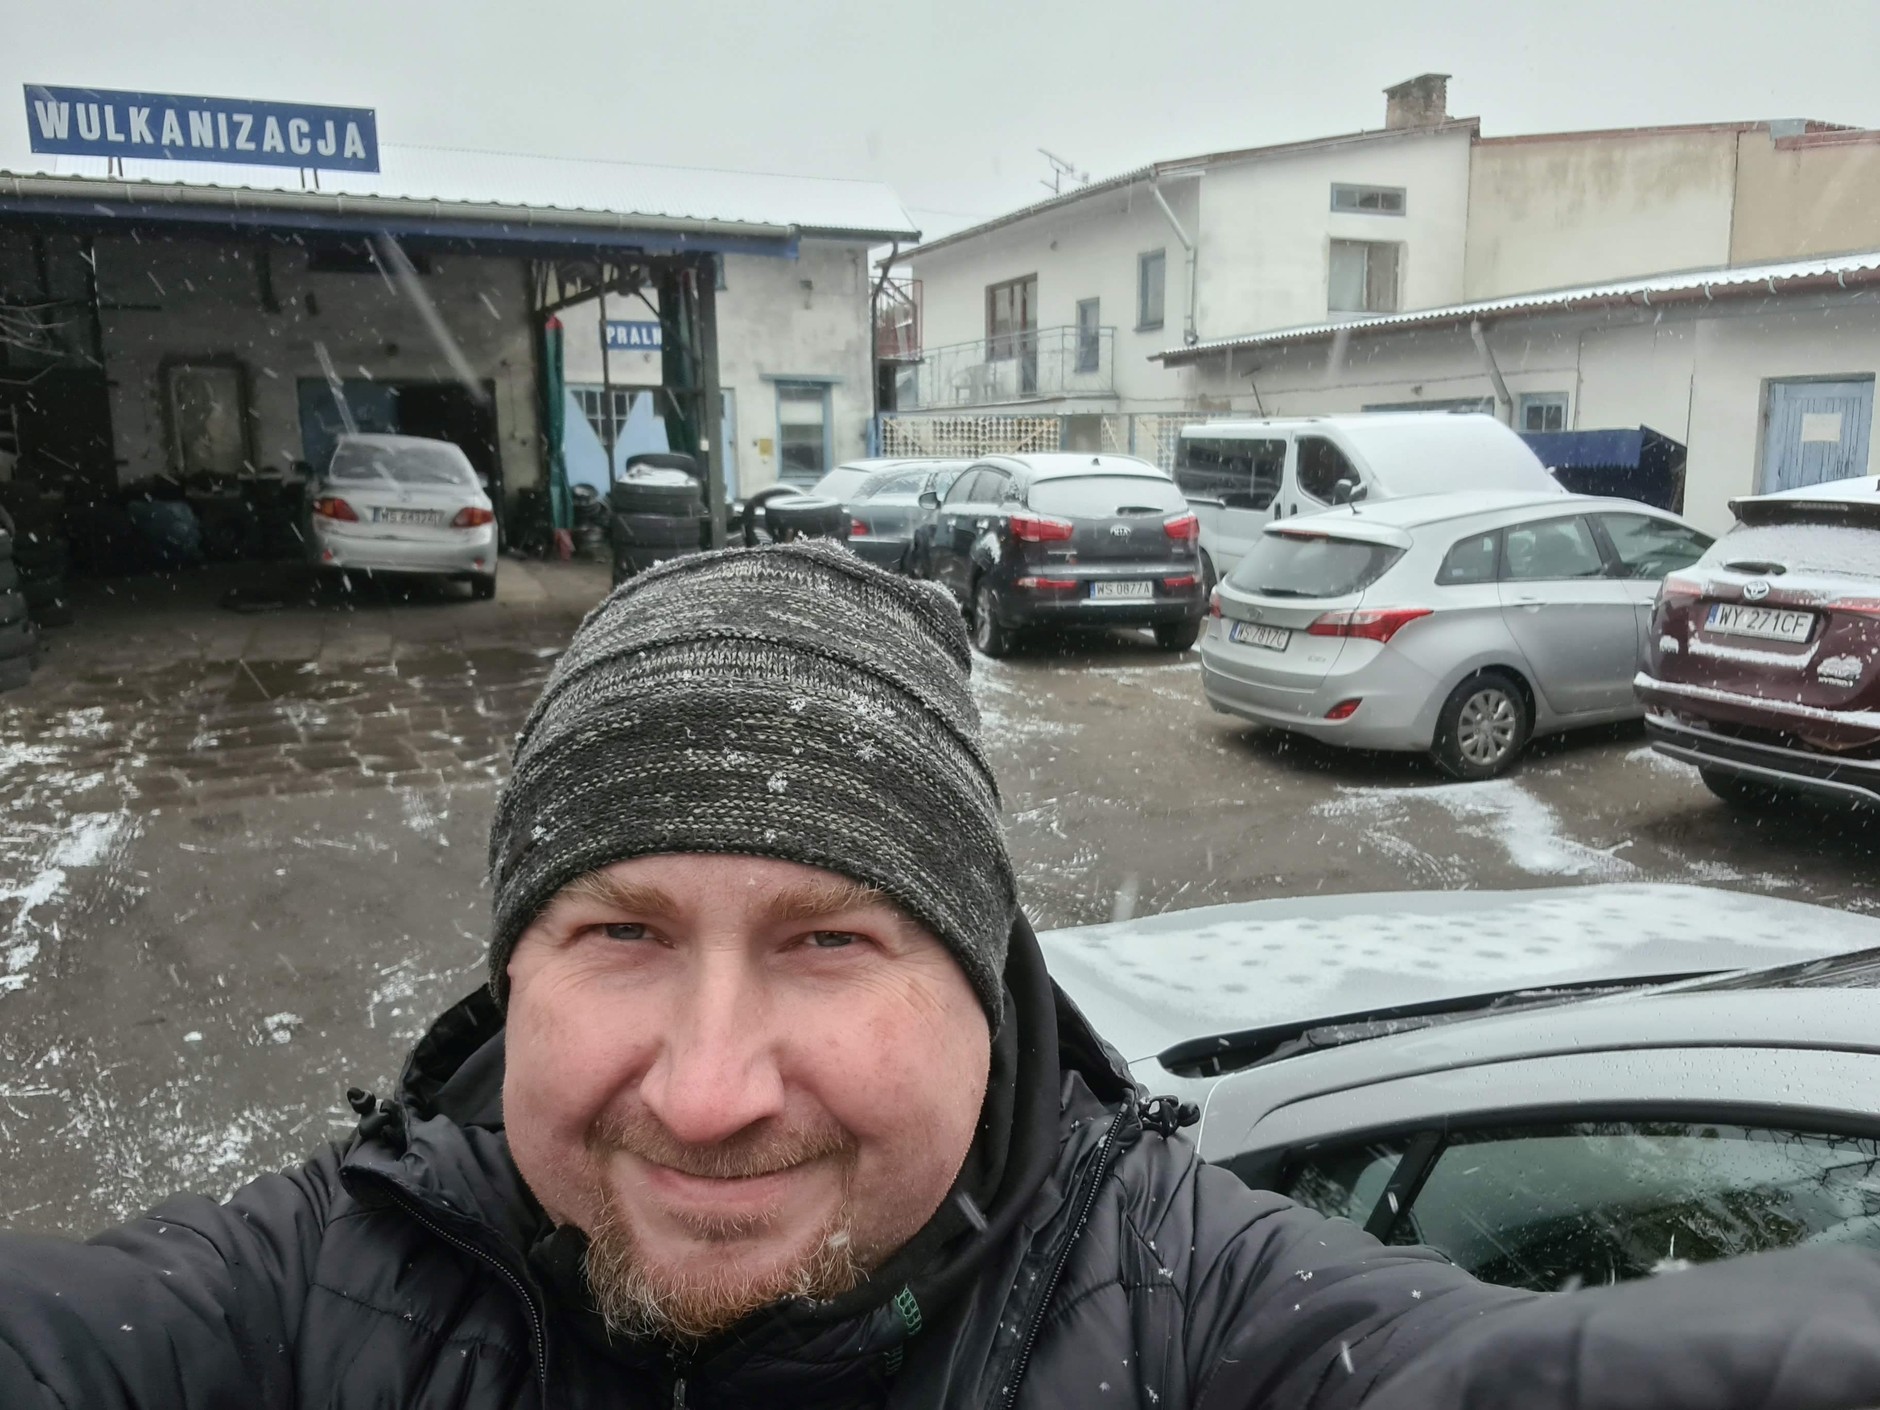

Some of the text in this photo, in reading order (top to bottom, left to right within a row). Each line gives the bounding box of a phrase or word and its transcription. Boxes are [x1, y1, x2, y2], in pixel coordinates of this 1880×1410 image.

[34, 99, 367, 160] WULKANIZACJA
[1096, 583, 1150, 596] WS 0877A
[1719, 607, 1809, 634] WY 271CF
[1236, 623, 1286, 647] WS 7817C
